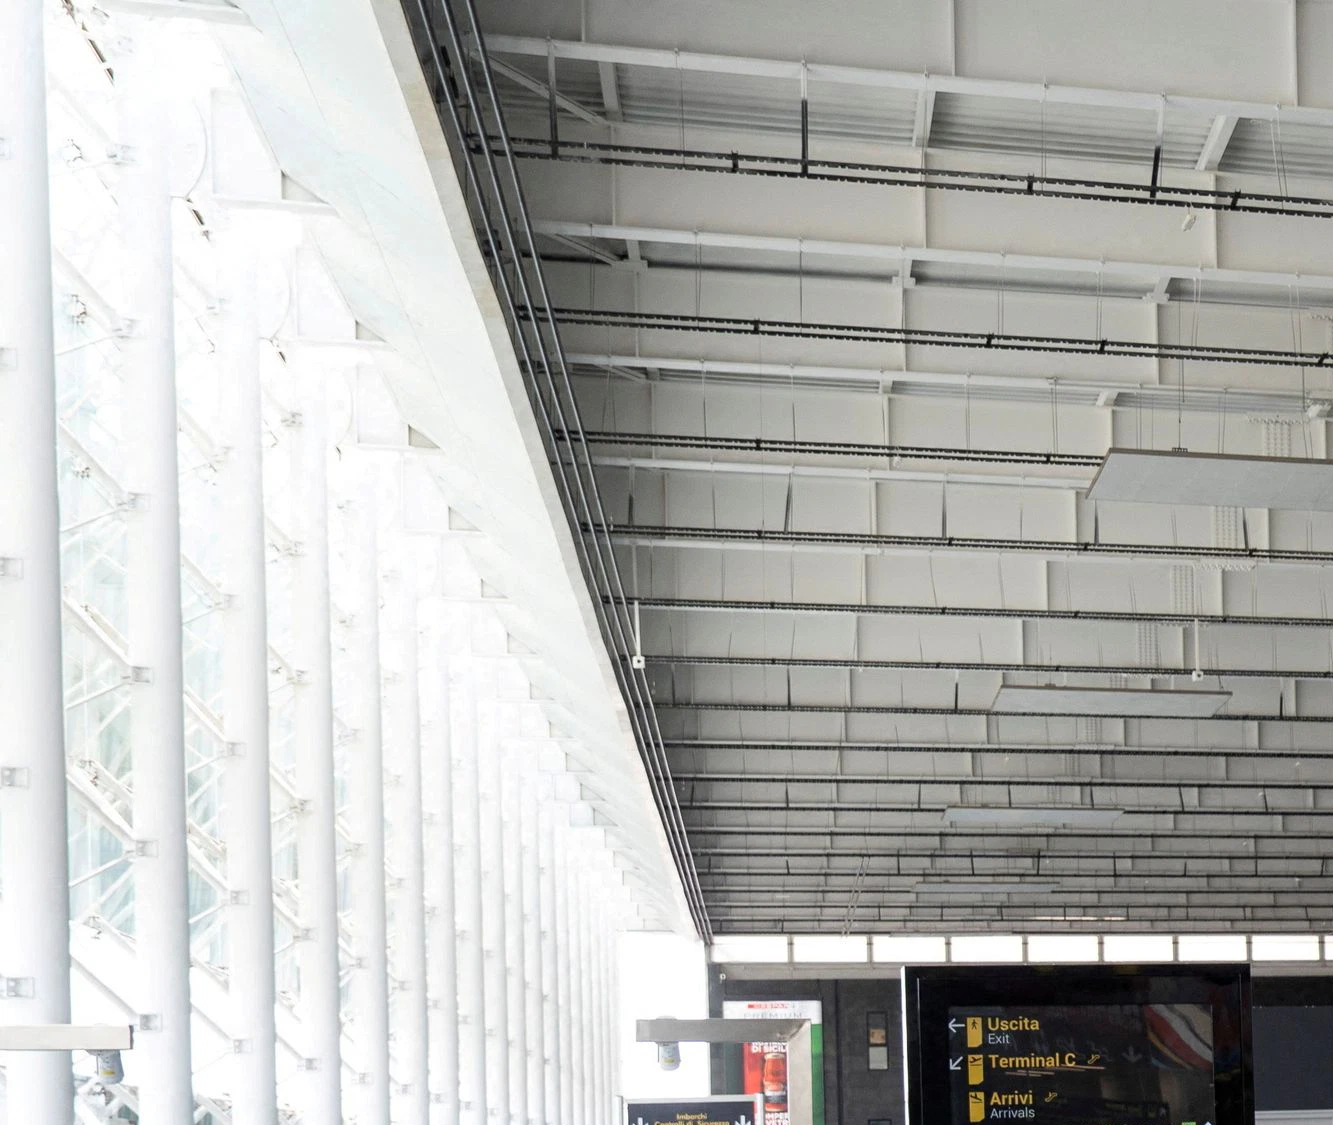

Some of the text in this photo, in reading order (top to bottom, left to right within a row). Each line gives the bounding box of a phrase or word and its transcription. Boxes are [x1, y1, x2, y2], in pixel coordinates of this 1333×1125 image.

[988, 1016, 1040, 1031] Uscita
[988, 1033, 1010, 1044] Exit
[988, 1053, 1076, 1068] Terminal C
[990, 1090, 1034, 1106] Arrivi
[676, 1113, 708, 1121] Imbarchi
[990, 1107, 1036, 1119] Arrivals
